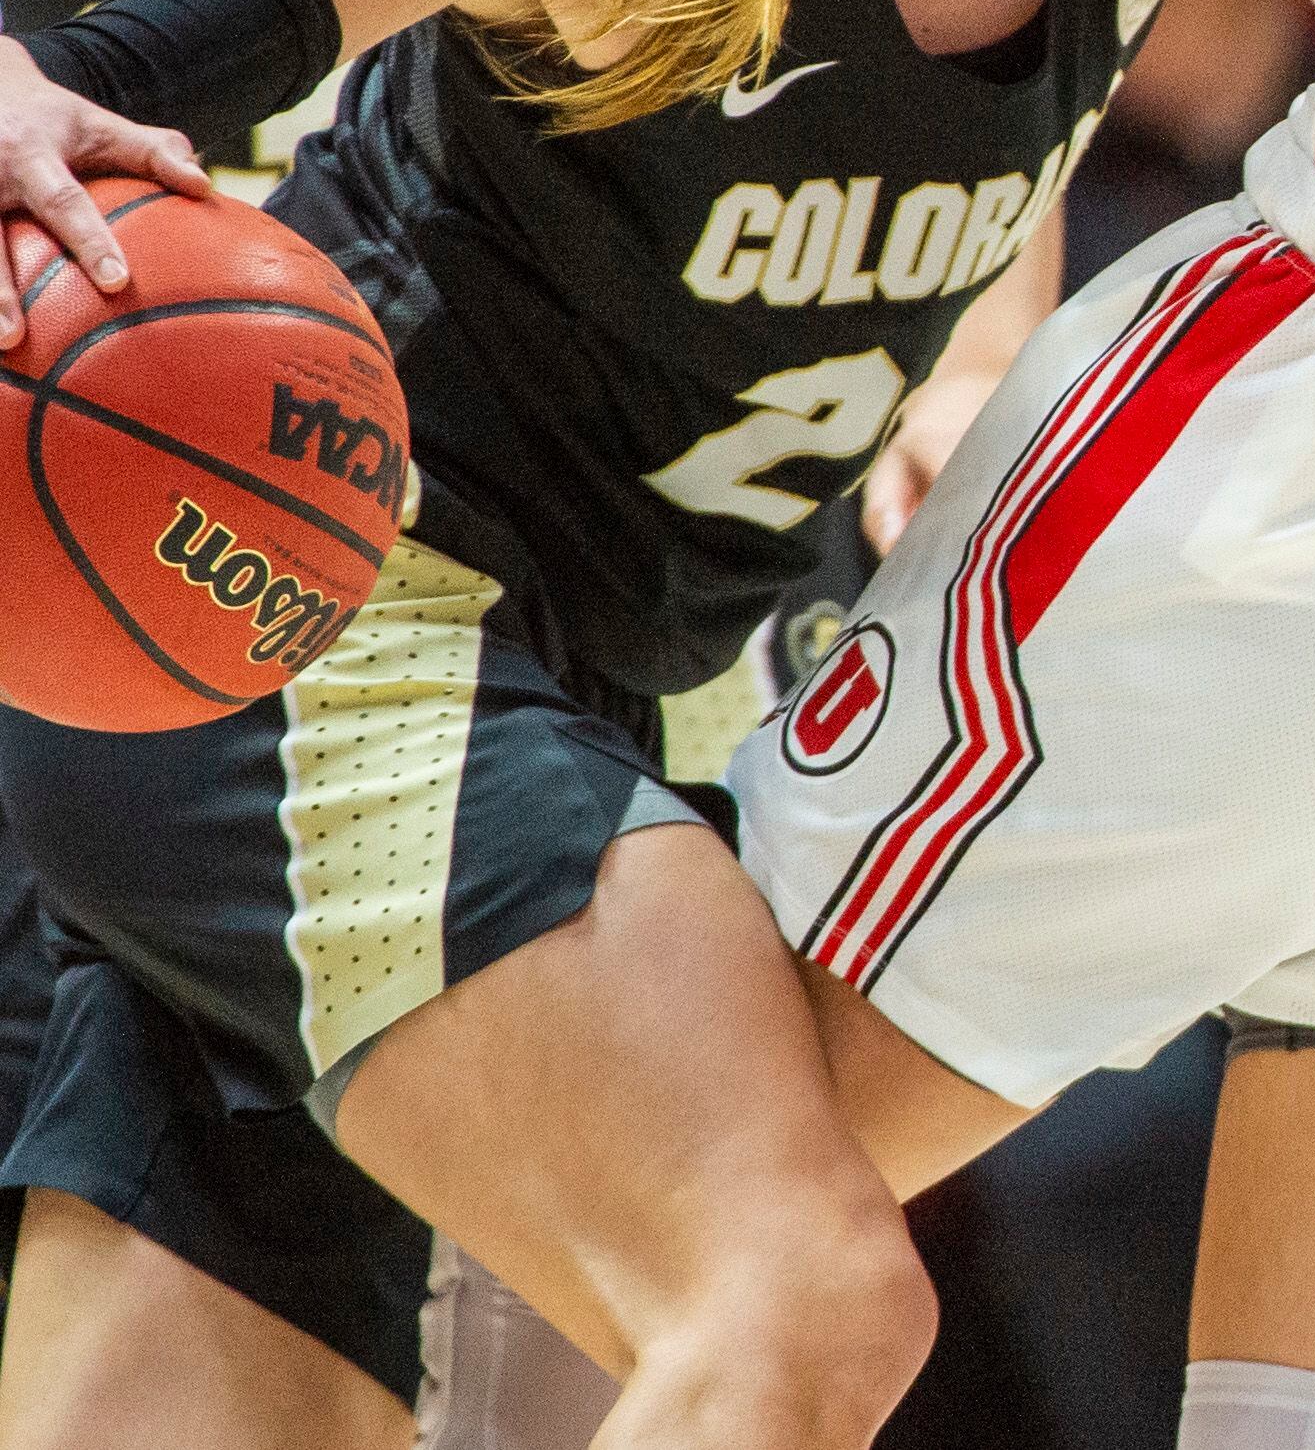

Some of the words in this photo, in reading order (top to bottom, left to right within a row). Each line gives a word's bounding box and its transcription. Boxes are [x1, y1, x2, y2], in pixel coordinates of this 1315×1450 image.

[682, 69, 1125, 306] COLORA
[268, 381, 403, 526] NCAA
[639, 346, 906, 533] 2
[794, 637, 882, 756] U
